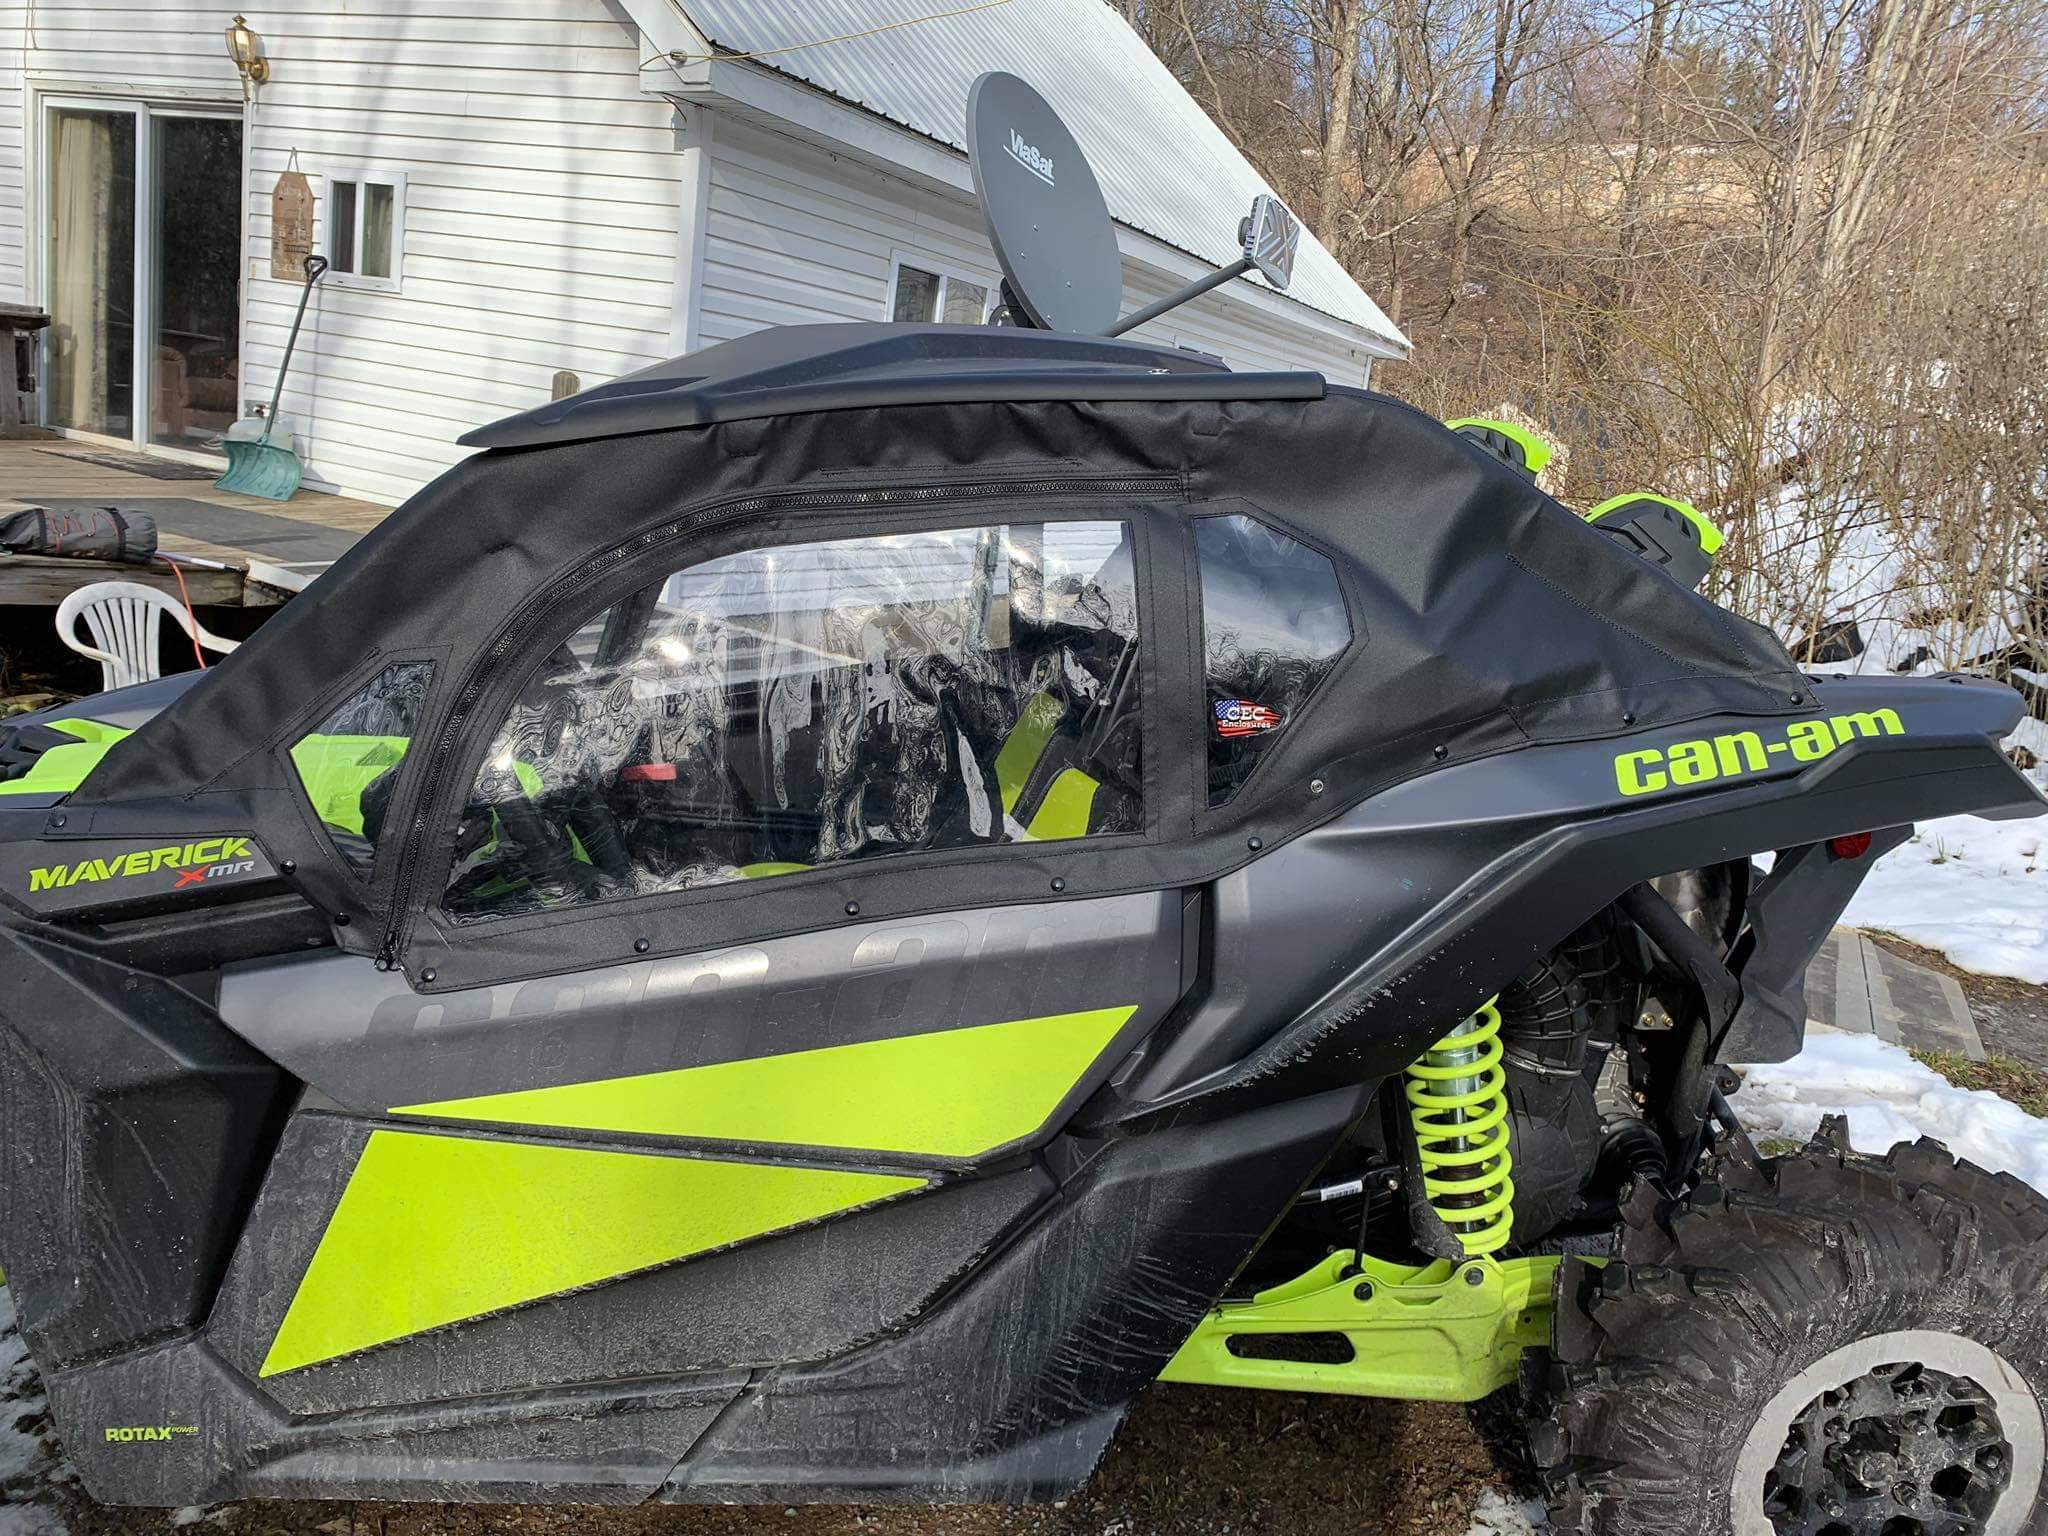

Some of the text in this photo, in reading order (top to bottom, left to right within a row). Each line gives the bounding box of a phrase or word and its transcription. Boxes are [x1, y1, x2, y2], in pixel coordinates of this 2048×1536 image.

[1010, 127, 1055, 180] ViaSat
[1222, 719, 1271, 728] Enclosures
[1227, 706, 1266, 721] CEC
[1613, 707, 1906, 797] can-am
[28, 837, 253, 893] MAVERICK
[105, 1426, 172, 1442] ROTAX
